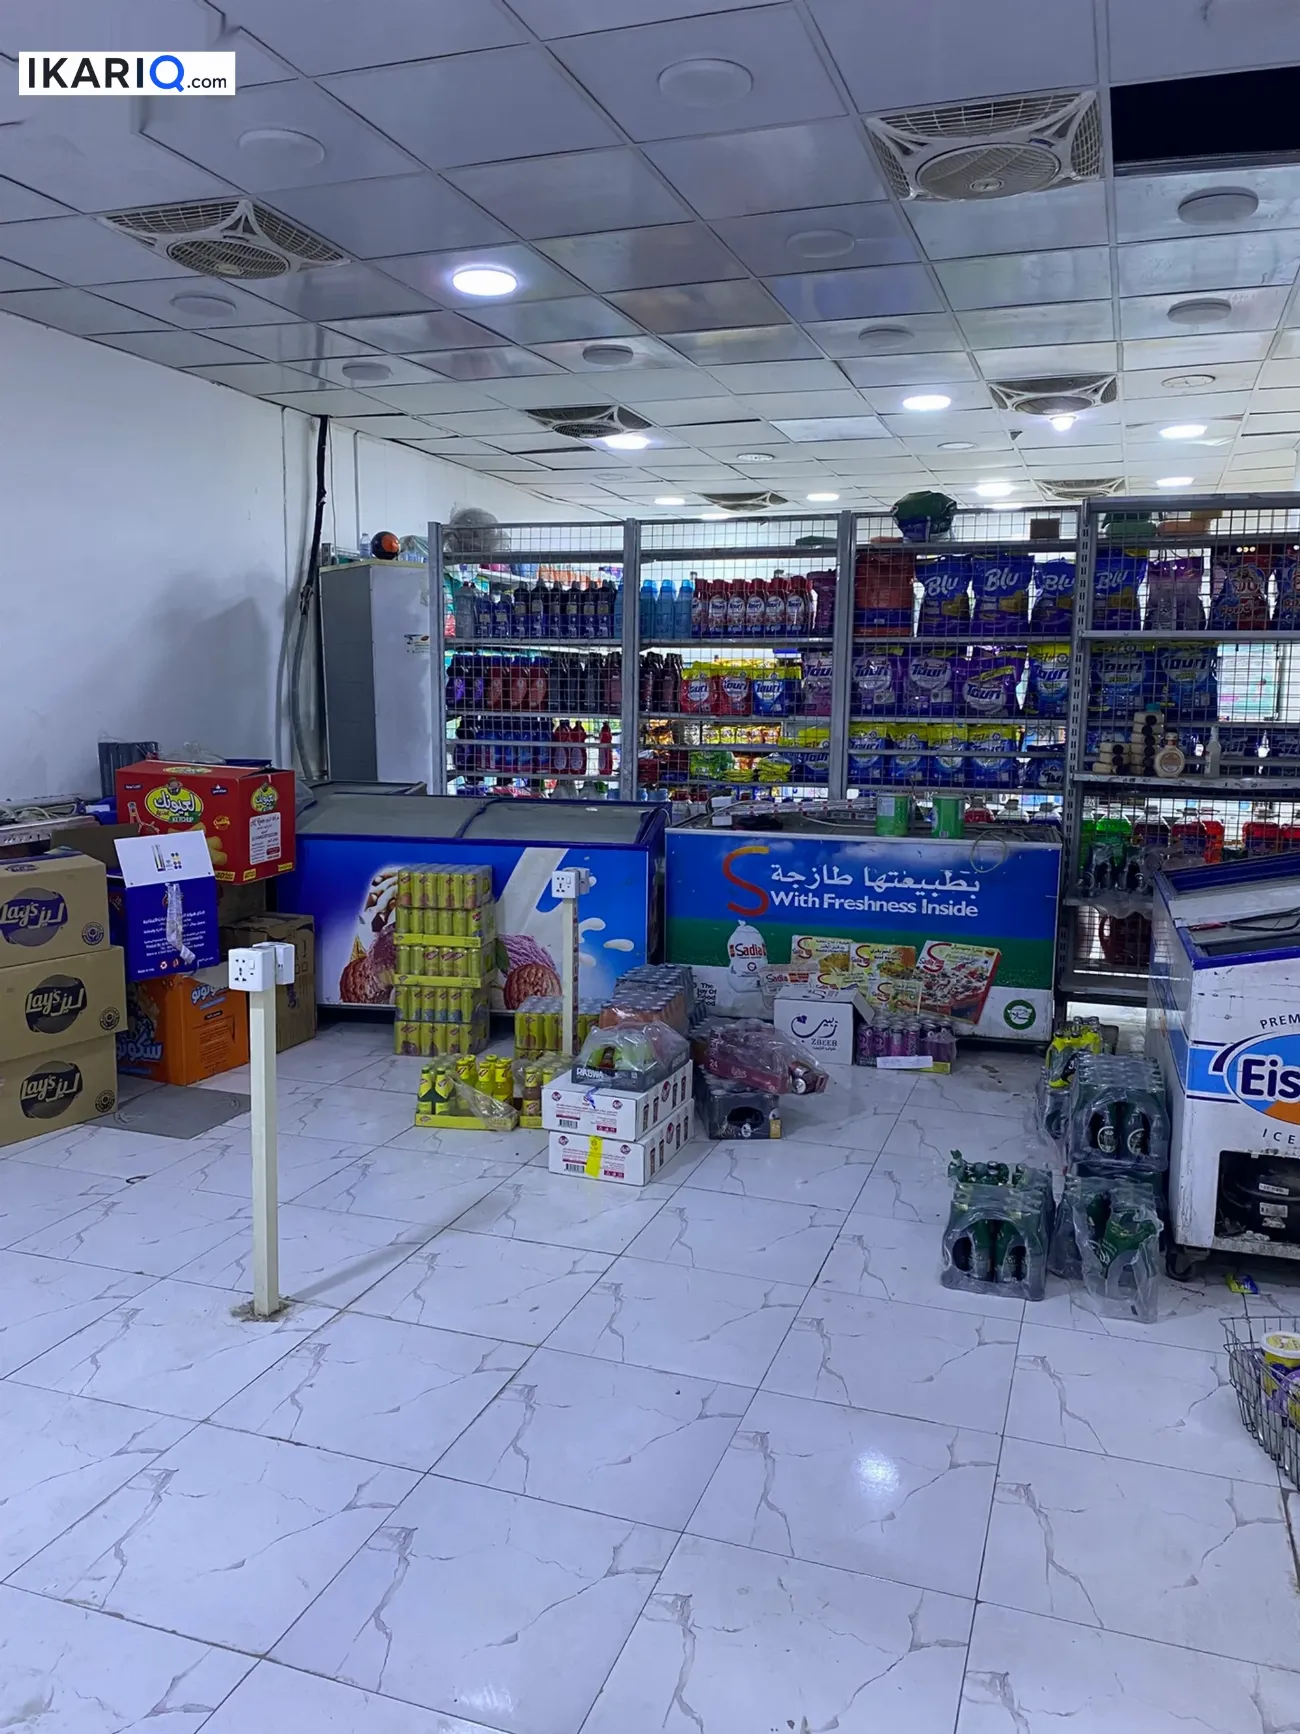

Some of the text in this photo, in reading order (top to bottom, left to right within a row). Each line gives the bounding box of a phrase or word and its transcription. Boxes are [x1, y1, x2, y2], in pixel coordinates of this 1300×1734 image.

[924, 574, 959, 597] Blu
[984, 568, 1020, 592] Blu
[1095, 570, 1129, 590] Blu
[771, 863, 853, 889] طازجة
[1, 901, 38, 926] Lay's
[771, 890, 979, 917] With Freshness Inside
[735, 942, 763, 957] Sadia
[26, 989, 60, 1013] Lay's
[21, 1074, 56, 1100] Lay's
[1262, 1128, 1296, 1145] ICE
